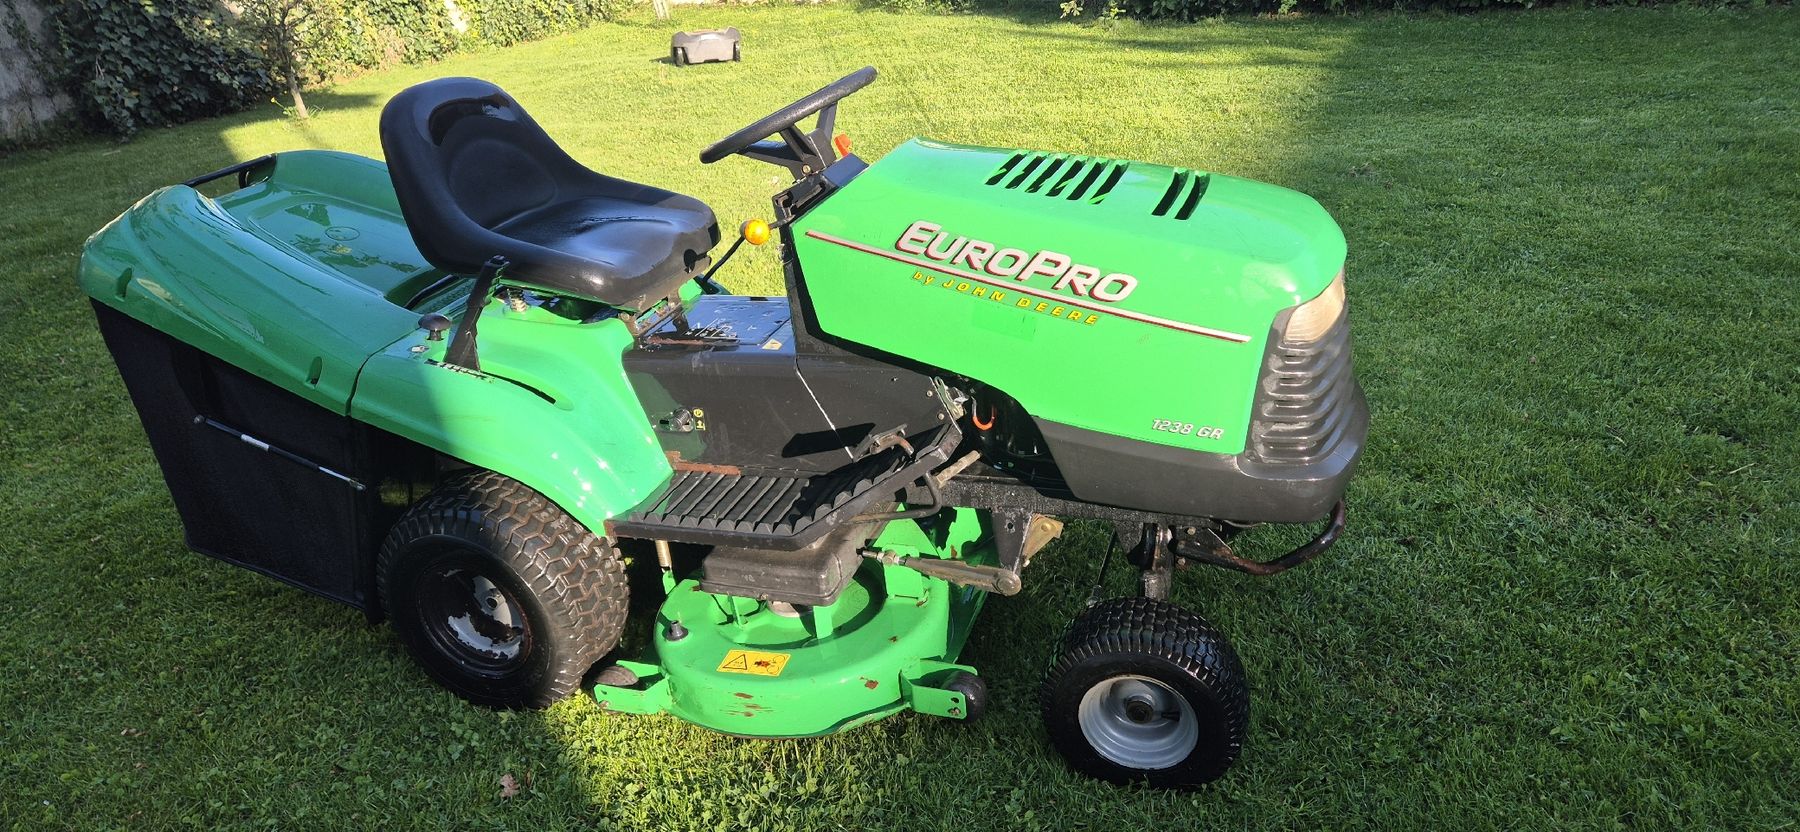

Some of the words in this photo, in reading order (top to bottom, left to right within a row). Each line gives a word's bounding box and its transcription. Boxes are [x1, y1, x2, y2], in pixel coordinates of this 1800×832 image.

[912, 271, 934, 285] by
[942, 280, 1005, 302] JOHN
[1016, 298, 1099, 325] DEERE
[1152, 418, 1194, 435] 1238
[1196, 426, 1224, 440] GR
